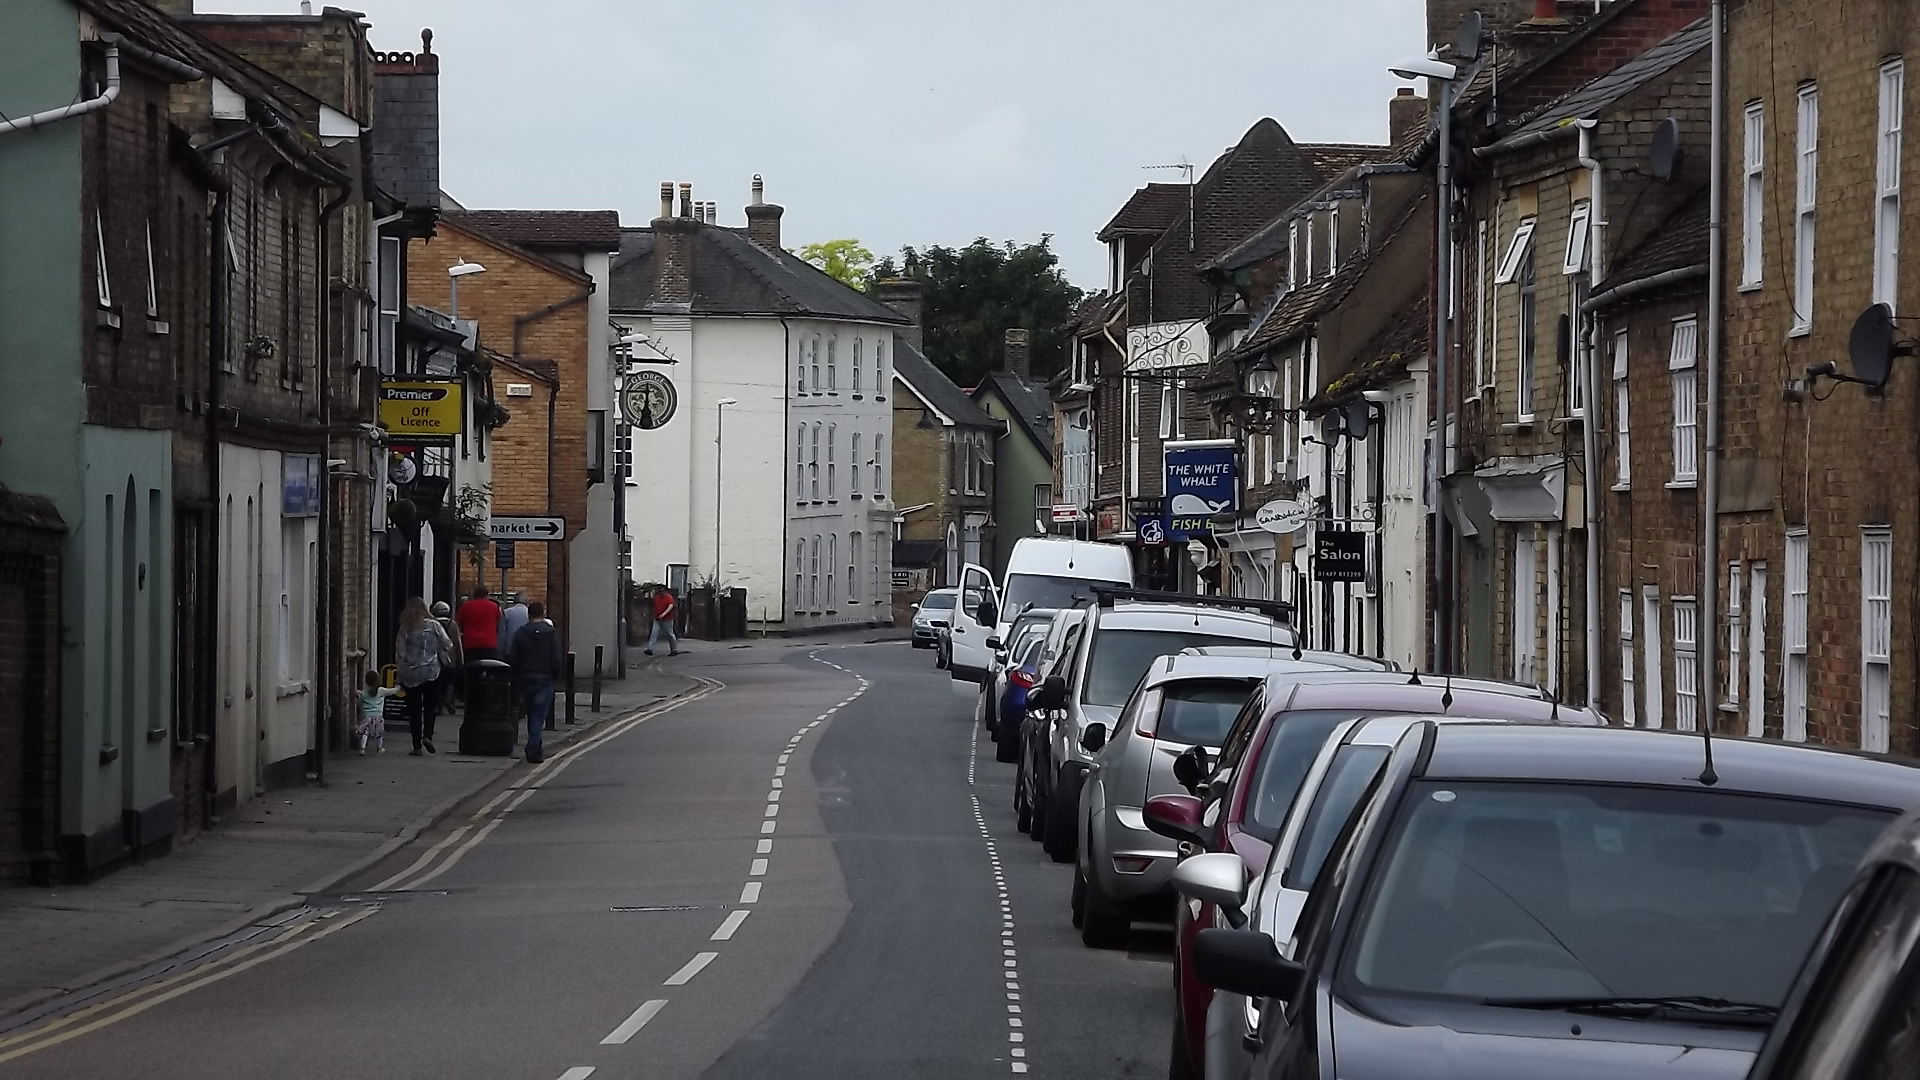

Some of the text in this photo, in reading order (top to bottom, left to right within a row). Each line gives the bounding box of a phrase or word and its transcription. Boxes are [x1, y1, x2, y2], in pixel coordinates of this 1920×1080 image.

[631, 373, 665, 384] GEORGE
[387, 389, 433, 400] Premier
[412, 407, 430, 417] Off
[400, 417, 441, 427] Licence
[633, 418, 663, 427] HEL
[1168, 463, 1230, 476] THE WHITE
[1180, 476, 1218, 487] WHALE
[1258, 509, 1305, 524] SANDWICH
[491, 523, 530, 534] market
[1171, 518, 1201, 531] FISH
[1319, 548, 1361, 560] Salon
